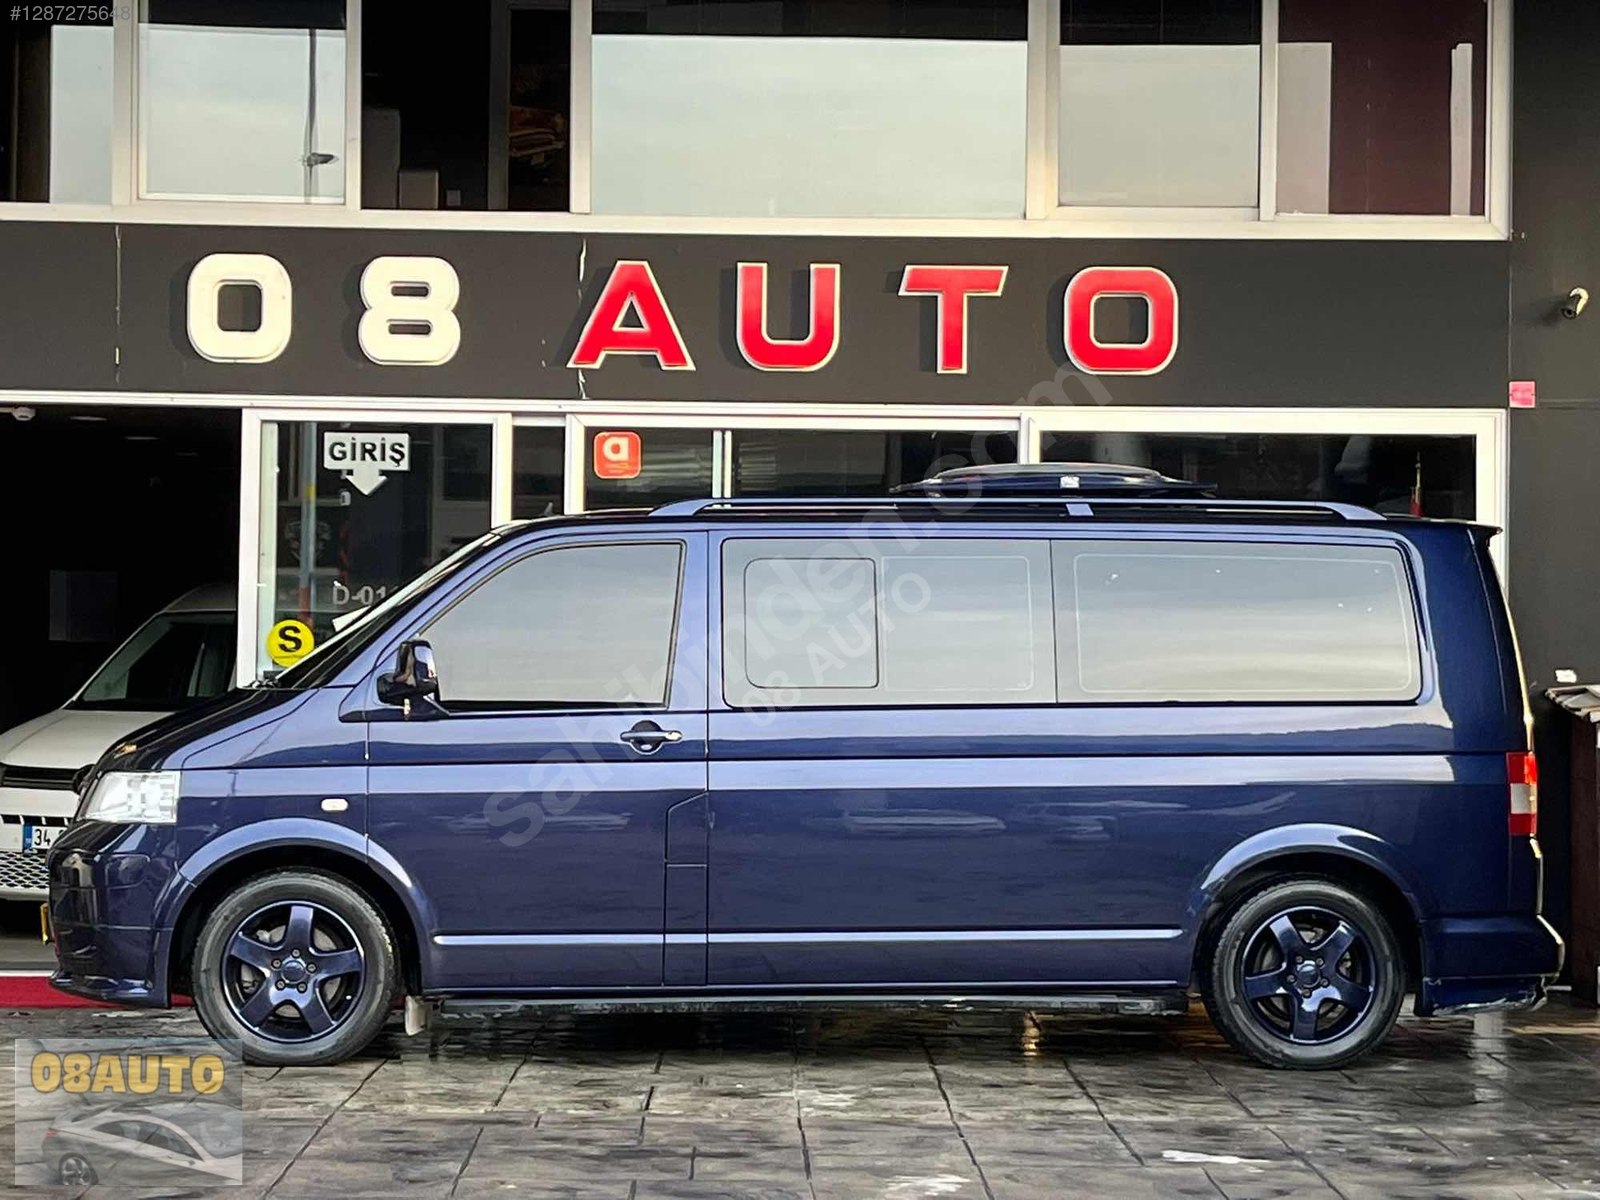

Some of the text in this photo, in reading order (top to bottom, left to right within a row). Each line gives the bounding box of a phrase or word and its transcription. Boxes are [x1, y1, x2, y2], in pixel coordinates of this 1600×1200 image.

[187, 254, 1179, 375] 08 AUTO
[329, 437, 405, 467] GİRİŞ
[278, 625, 302, 653] S
